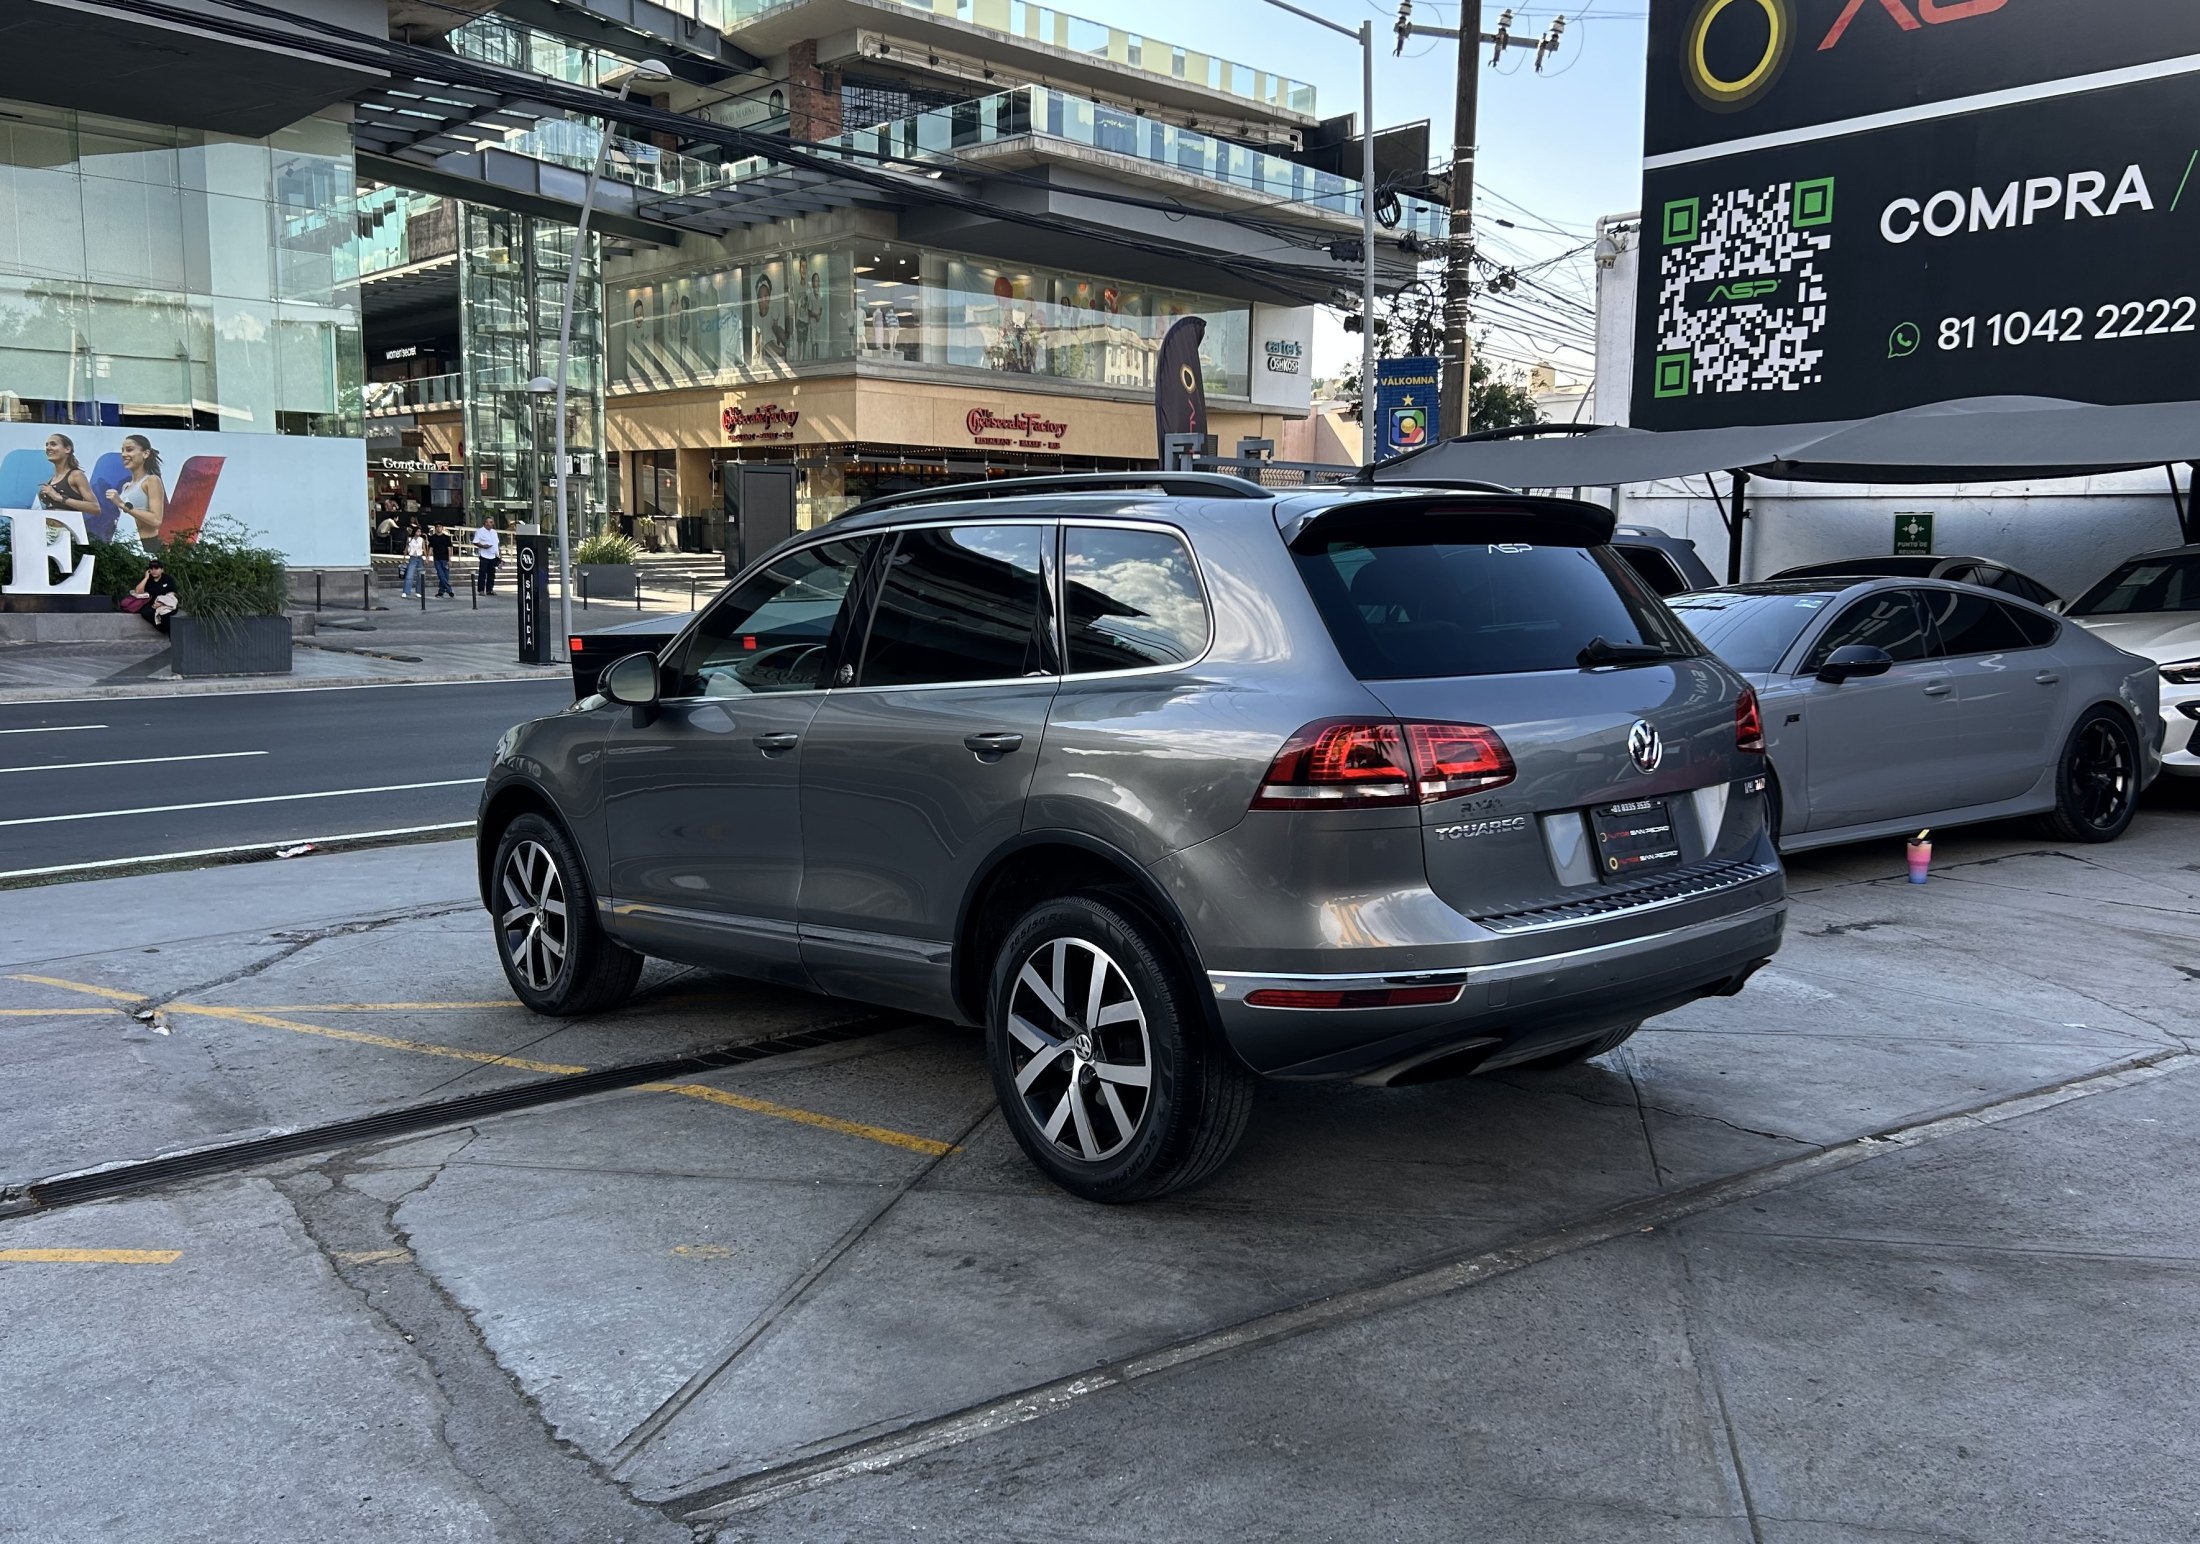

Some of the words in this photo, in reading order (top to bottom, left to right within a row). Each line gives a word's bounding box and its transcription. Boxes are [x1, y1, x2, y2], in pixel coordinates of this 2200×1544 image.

[1880, 164, 2154, 243] COMPRA
[1706, 280, 1778, 302] ASP
[1937, 316, 1976, 350] 81
[1986, 307, 2084, 346] 1042
[2094, 296, 2198, 339] 2222
[1264, 340, 1302, 356] carter's
[1380, 375, 1435, 386] VÄLKOMNA
[761, 404, 799, 430] Factory
[966, 408, 1028, 435] Cheesecake
[1021, 412, 1068, 438] Factory
[382, 457, 415, 472] Gong
[416, 458, 437, 471] cha
[0, 508, 96, 595] E
[525, 579, 533, 645] SALIDA
[1434, 817, 1526, 841] TOUAREG
